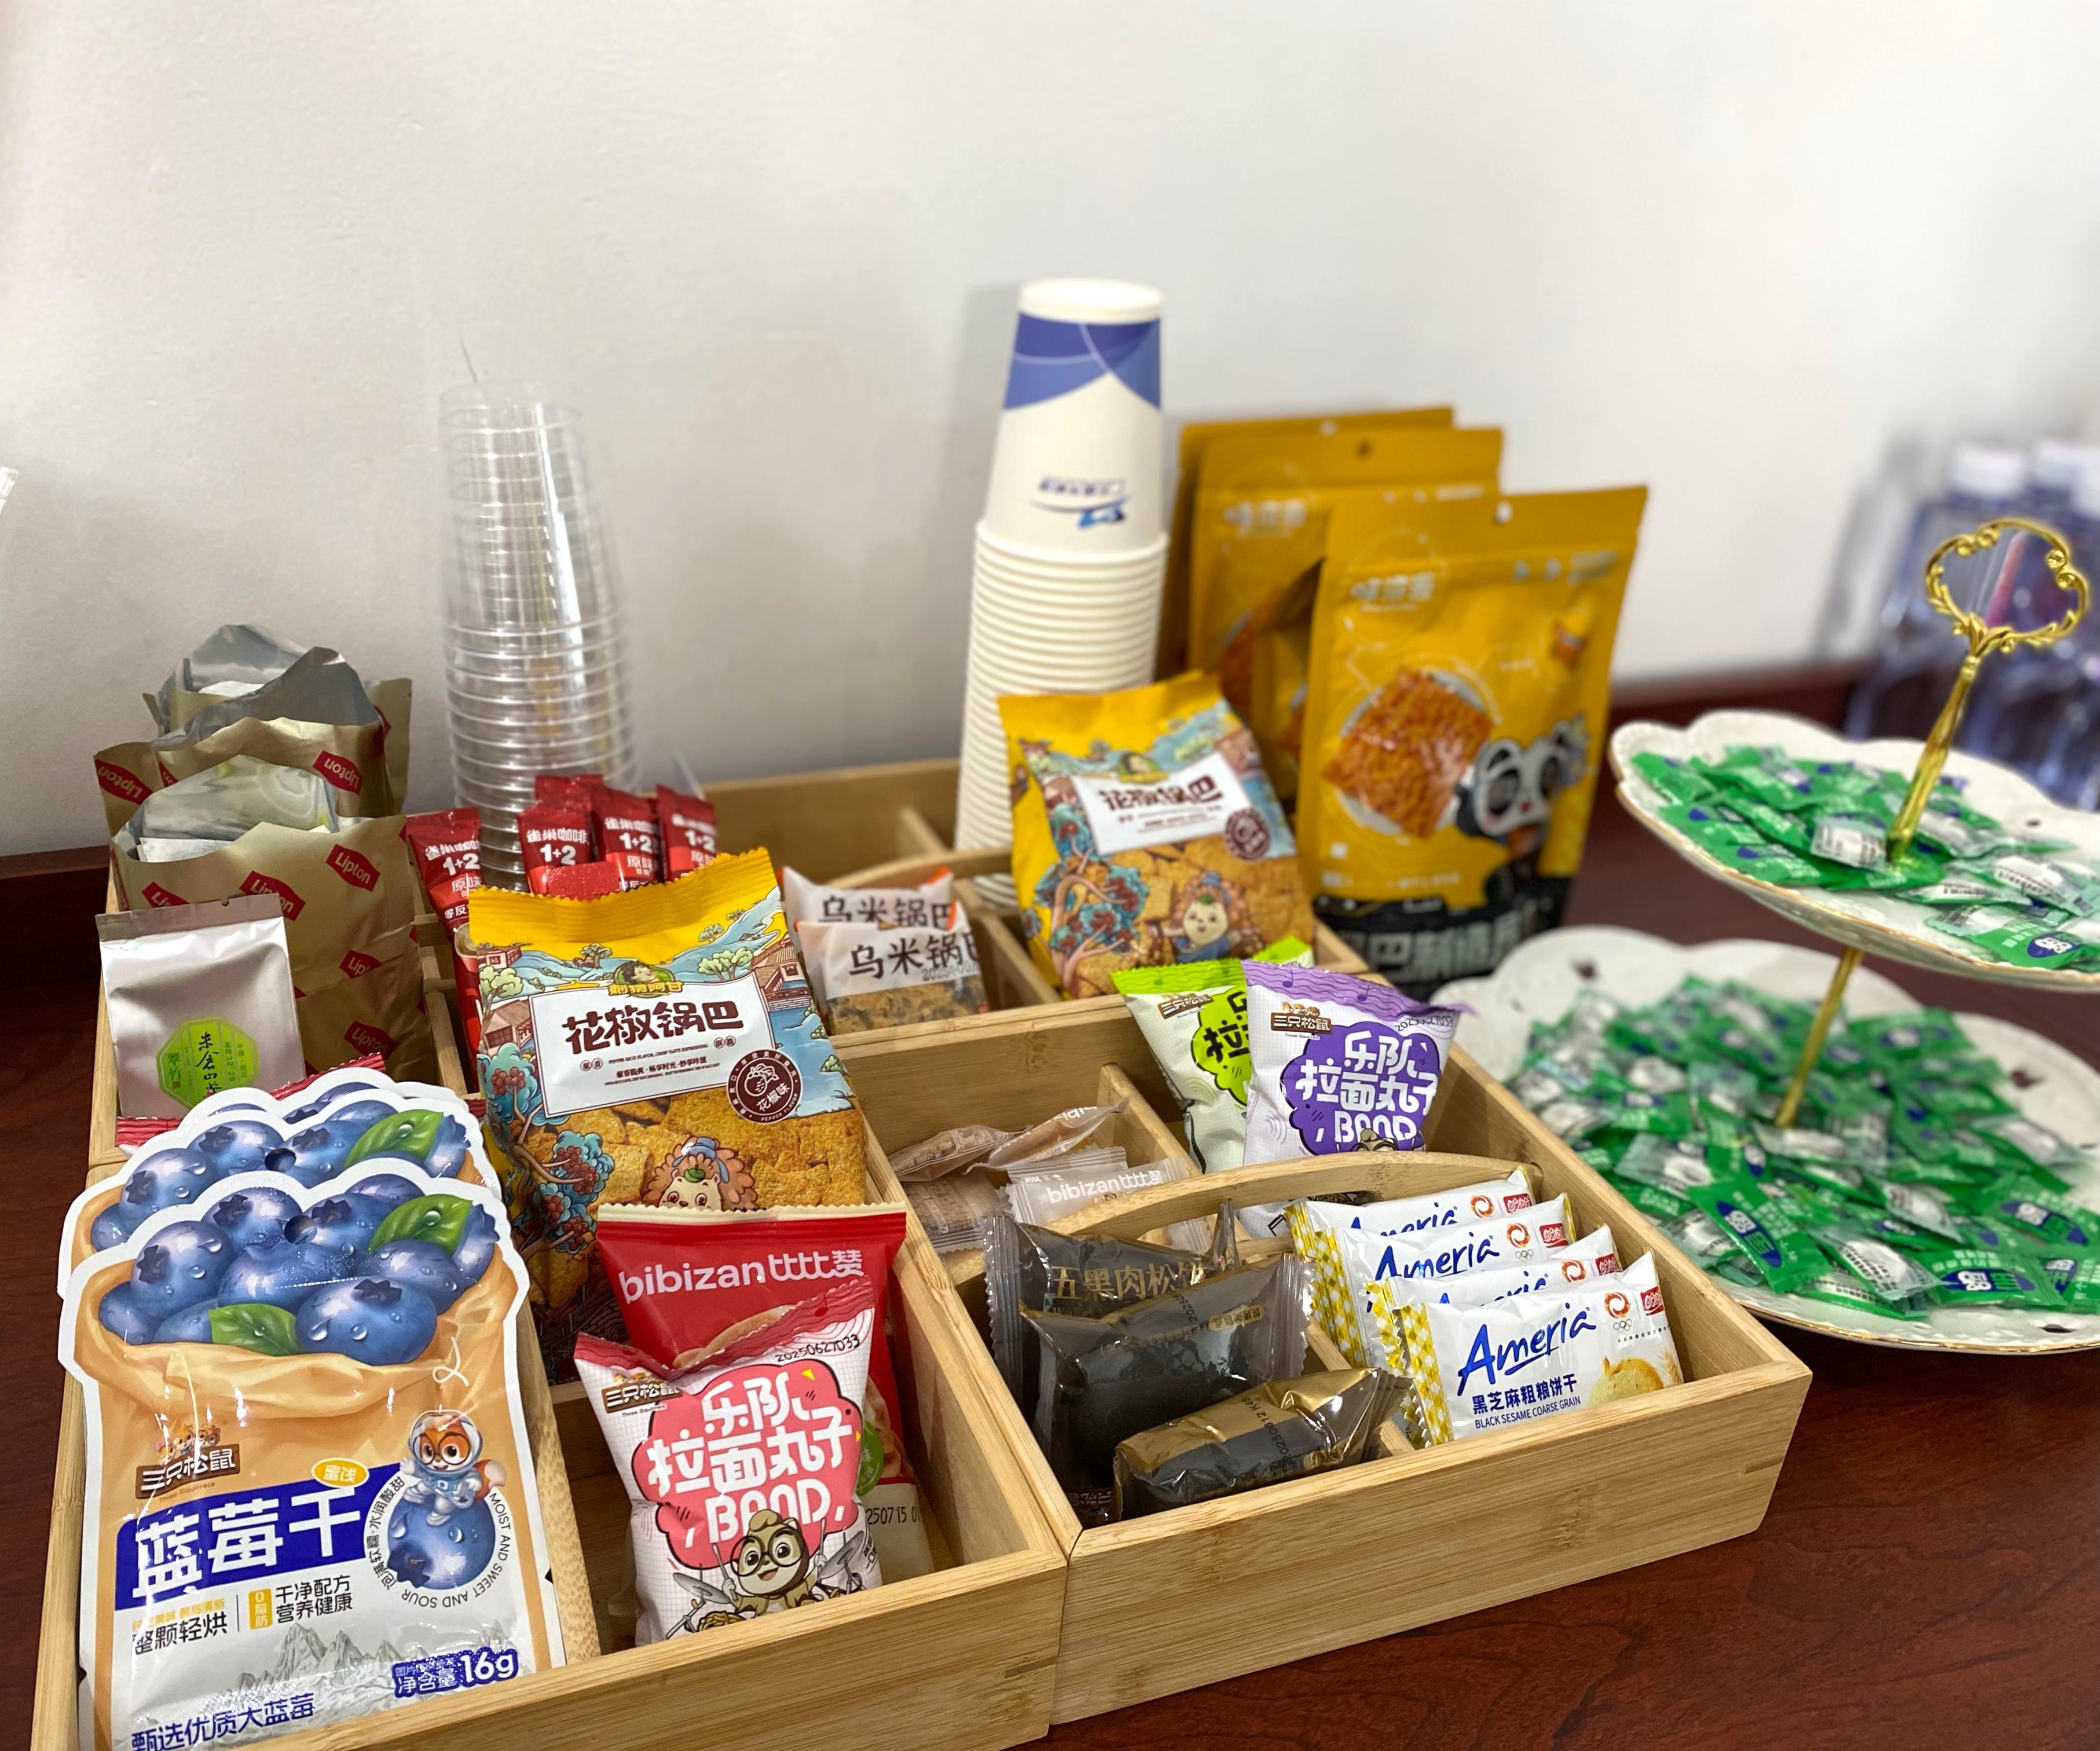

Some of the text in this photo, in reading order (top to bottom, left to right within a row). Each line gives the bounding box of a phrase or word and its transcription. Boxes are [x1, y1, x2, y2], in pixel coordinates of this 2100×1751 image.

[97, 766, 143, 798] Lipton
[324, 758, 359, 789] Lipton
[540, 844, 576, 866] 1+2
[620, 833, 653, 853] 1+2
[335, 852, 371, 884] Lipton
[443, 853, 481, 876] 1+2
[444, 904, 470, 919] 零反
[561, 1000, 744, 1055] 花椒锅巴
[1274, 1015, 1330, 1031] 三只松鼠
[1344, 1030, 1417, 1078] 乐队
[756, 1082, 790, 1112] 花椒味
[1295, 1058, 1439, 1116] 拉面丸子
[618, 1261, 766, 1305] bibizan
[1457, 1302, 1596, 1397] Ameria
[703, 1371, 809, 1435] 乐队
[1472, 1373, 1578, 1415] 黑芝麻粗粮饼干
[1475, 1395, 1582, 1429] BLACK SESAME COARSE GRAIN
[141, 1448, 235, 1492] 三只松鼠
[646, 1402, 853, 1497] 拉面丸子
[133, 1486, 361, 1599] 蓝莓干
[401, 1493, 511, 1609] MOIST AND SWEET AND SOUR
[276, 1575, 351, 1604] 干净配方
[276, 1592, 353, 1624] 营养健康
[132, 1611, 228, 1655] 整颗轻烘
[398, 1668, 456, 1694] 净含量
[460, 1651, 514, 1683] 16g
[131, 1693, 315, 1751] 甄选优质大蓝莓
